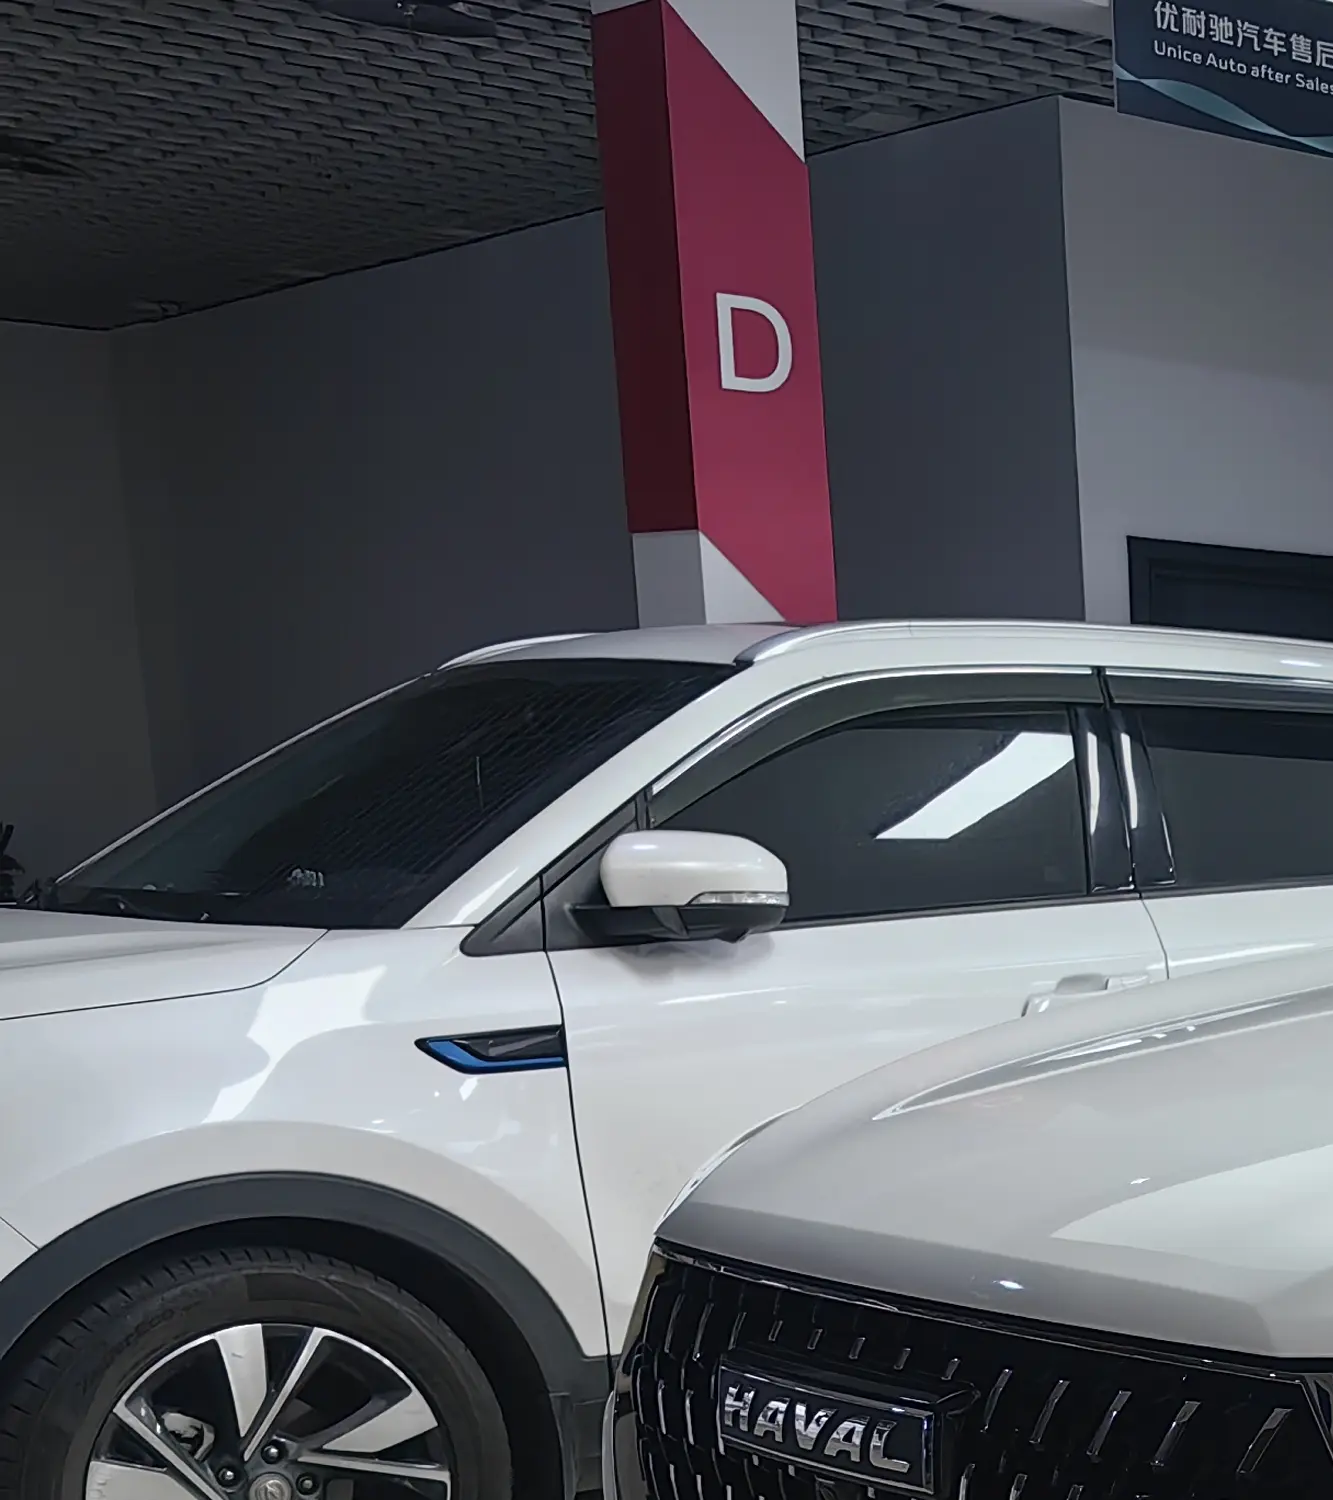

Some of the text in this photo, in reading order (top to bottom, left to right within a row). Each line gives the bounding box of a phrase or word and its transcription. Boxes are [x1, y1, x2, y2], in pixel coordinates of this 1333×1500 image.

[1153, 39, 1203, 66] Unice
[1205, 52, 1247, 76] Auto
[1250, 63, 1292, 86] after
[715, 292, 793, 393] D
[724, 1383, 911, 1474] HAVAL
